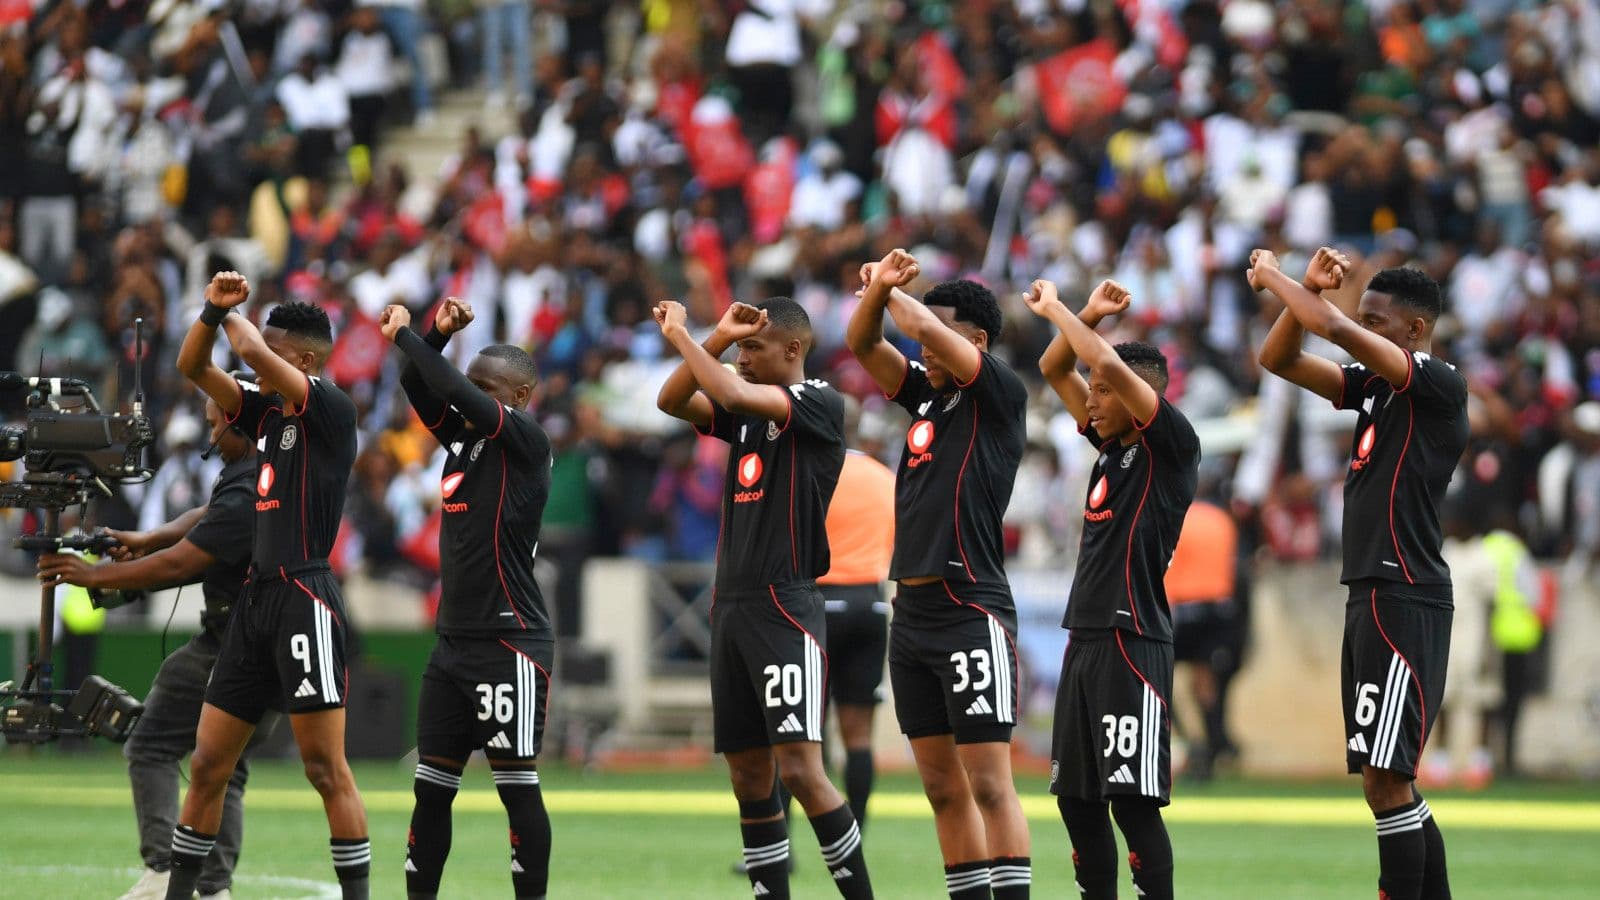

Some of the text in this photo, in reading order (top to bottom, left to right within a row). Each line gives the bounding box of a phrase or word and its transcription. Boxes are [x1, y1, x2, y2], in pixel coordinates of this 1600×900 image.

[291, 633, 311, 673] 9
[950, 649, 992, 693] 33
[475, 683, 514, 724] 36
[763, 663, 803, 708] 20
[1101, 714, 1139, 758] 38
